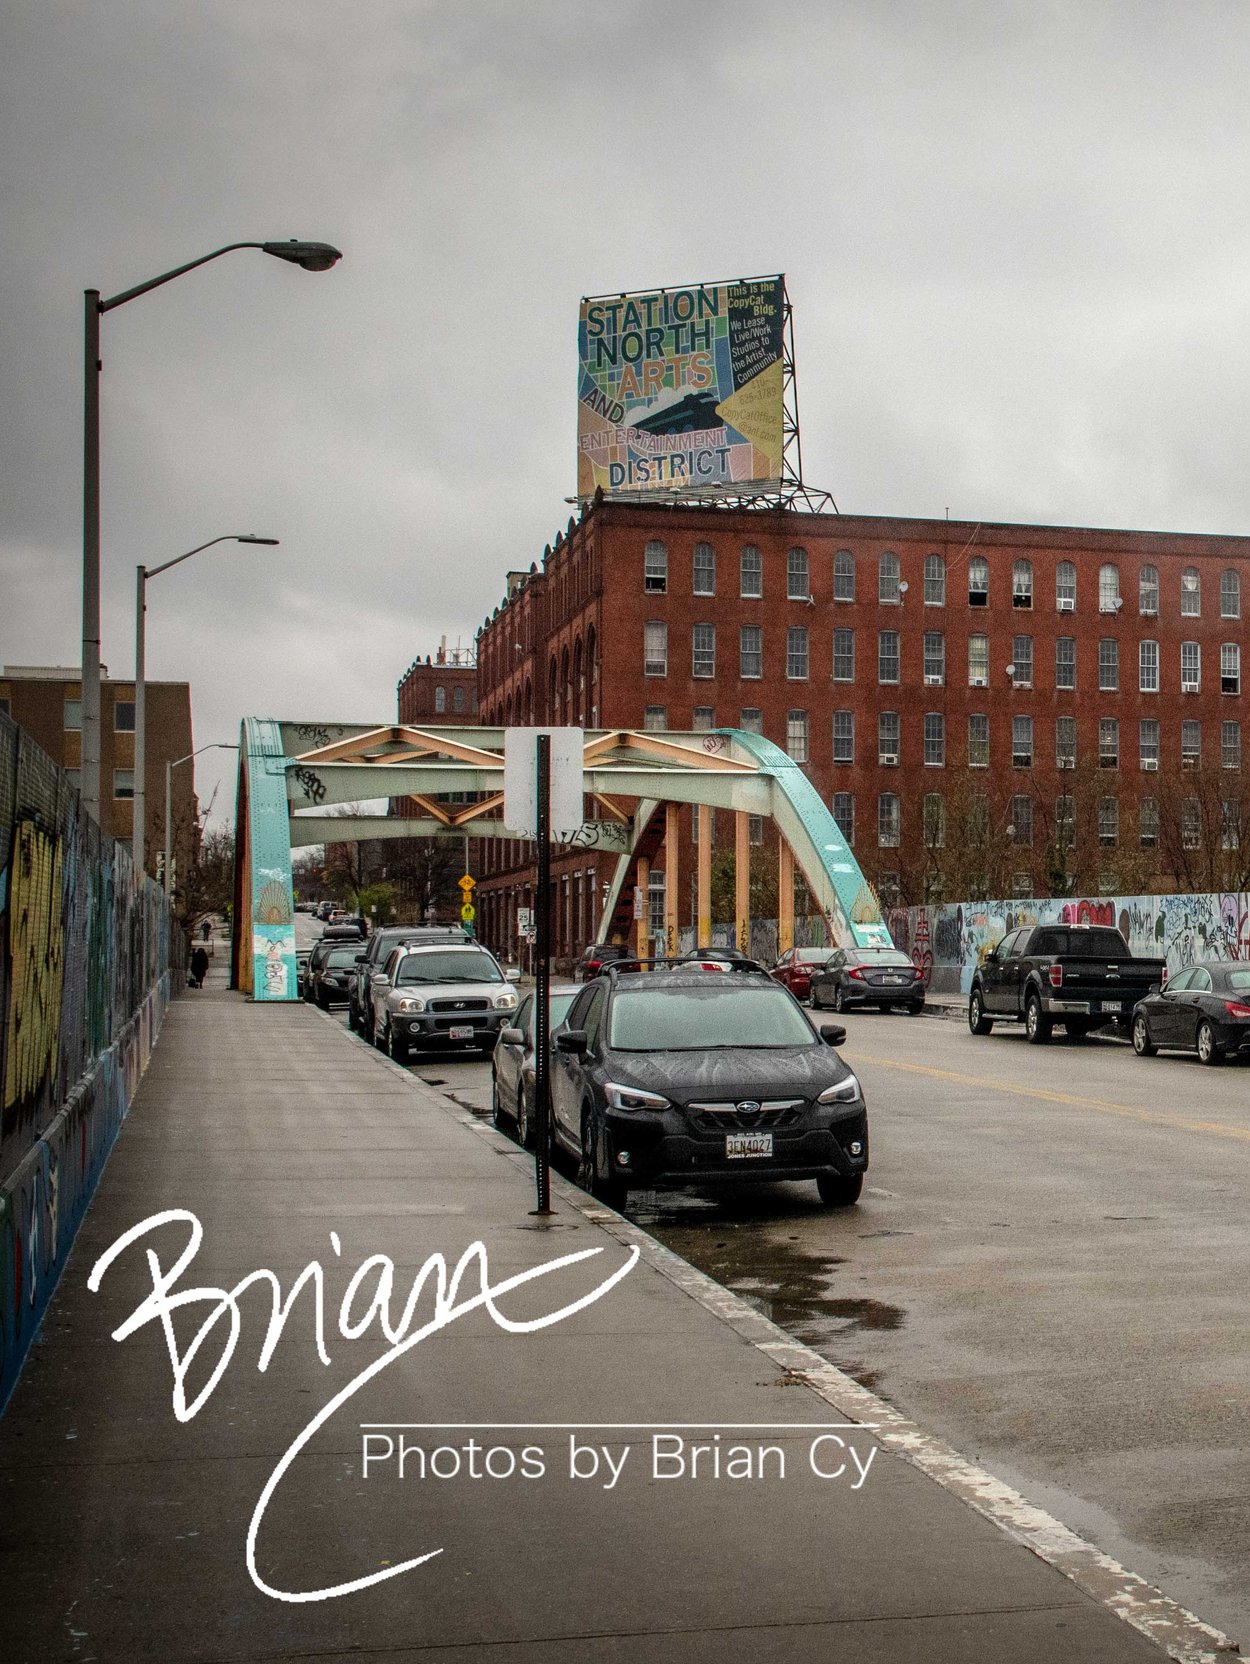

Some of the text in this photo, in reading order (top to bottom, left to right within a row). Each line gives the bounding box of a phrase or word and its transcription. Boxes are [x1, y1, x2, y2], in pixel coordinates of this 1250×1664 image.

[729, 282, 775, 297] This is the
[587, 287, 719, 337] STATION
[728, 295, 764, 309] CopyCat
[754, 304, 777, 316] Bldg.
[730, 316, 766, 331] We Lease
[734, 324, 772, 344] Live/Work
[597, 319, 710, 368] NORTH
[731, 336, 770, 358] Studios to
[732, 347, 766, 372] the Artist
[736, 351, 778, 384] Community
[618, 353, 712, 400] ARTS
[583, 387, 625, 424] AND
[580, 428, 727, 451] ENTERTAINMENT
[610, 448, 731, 487] DISTRICT
